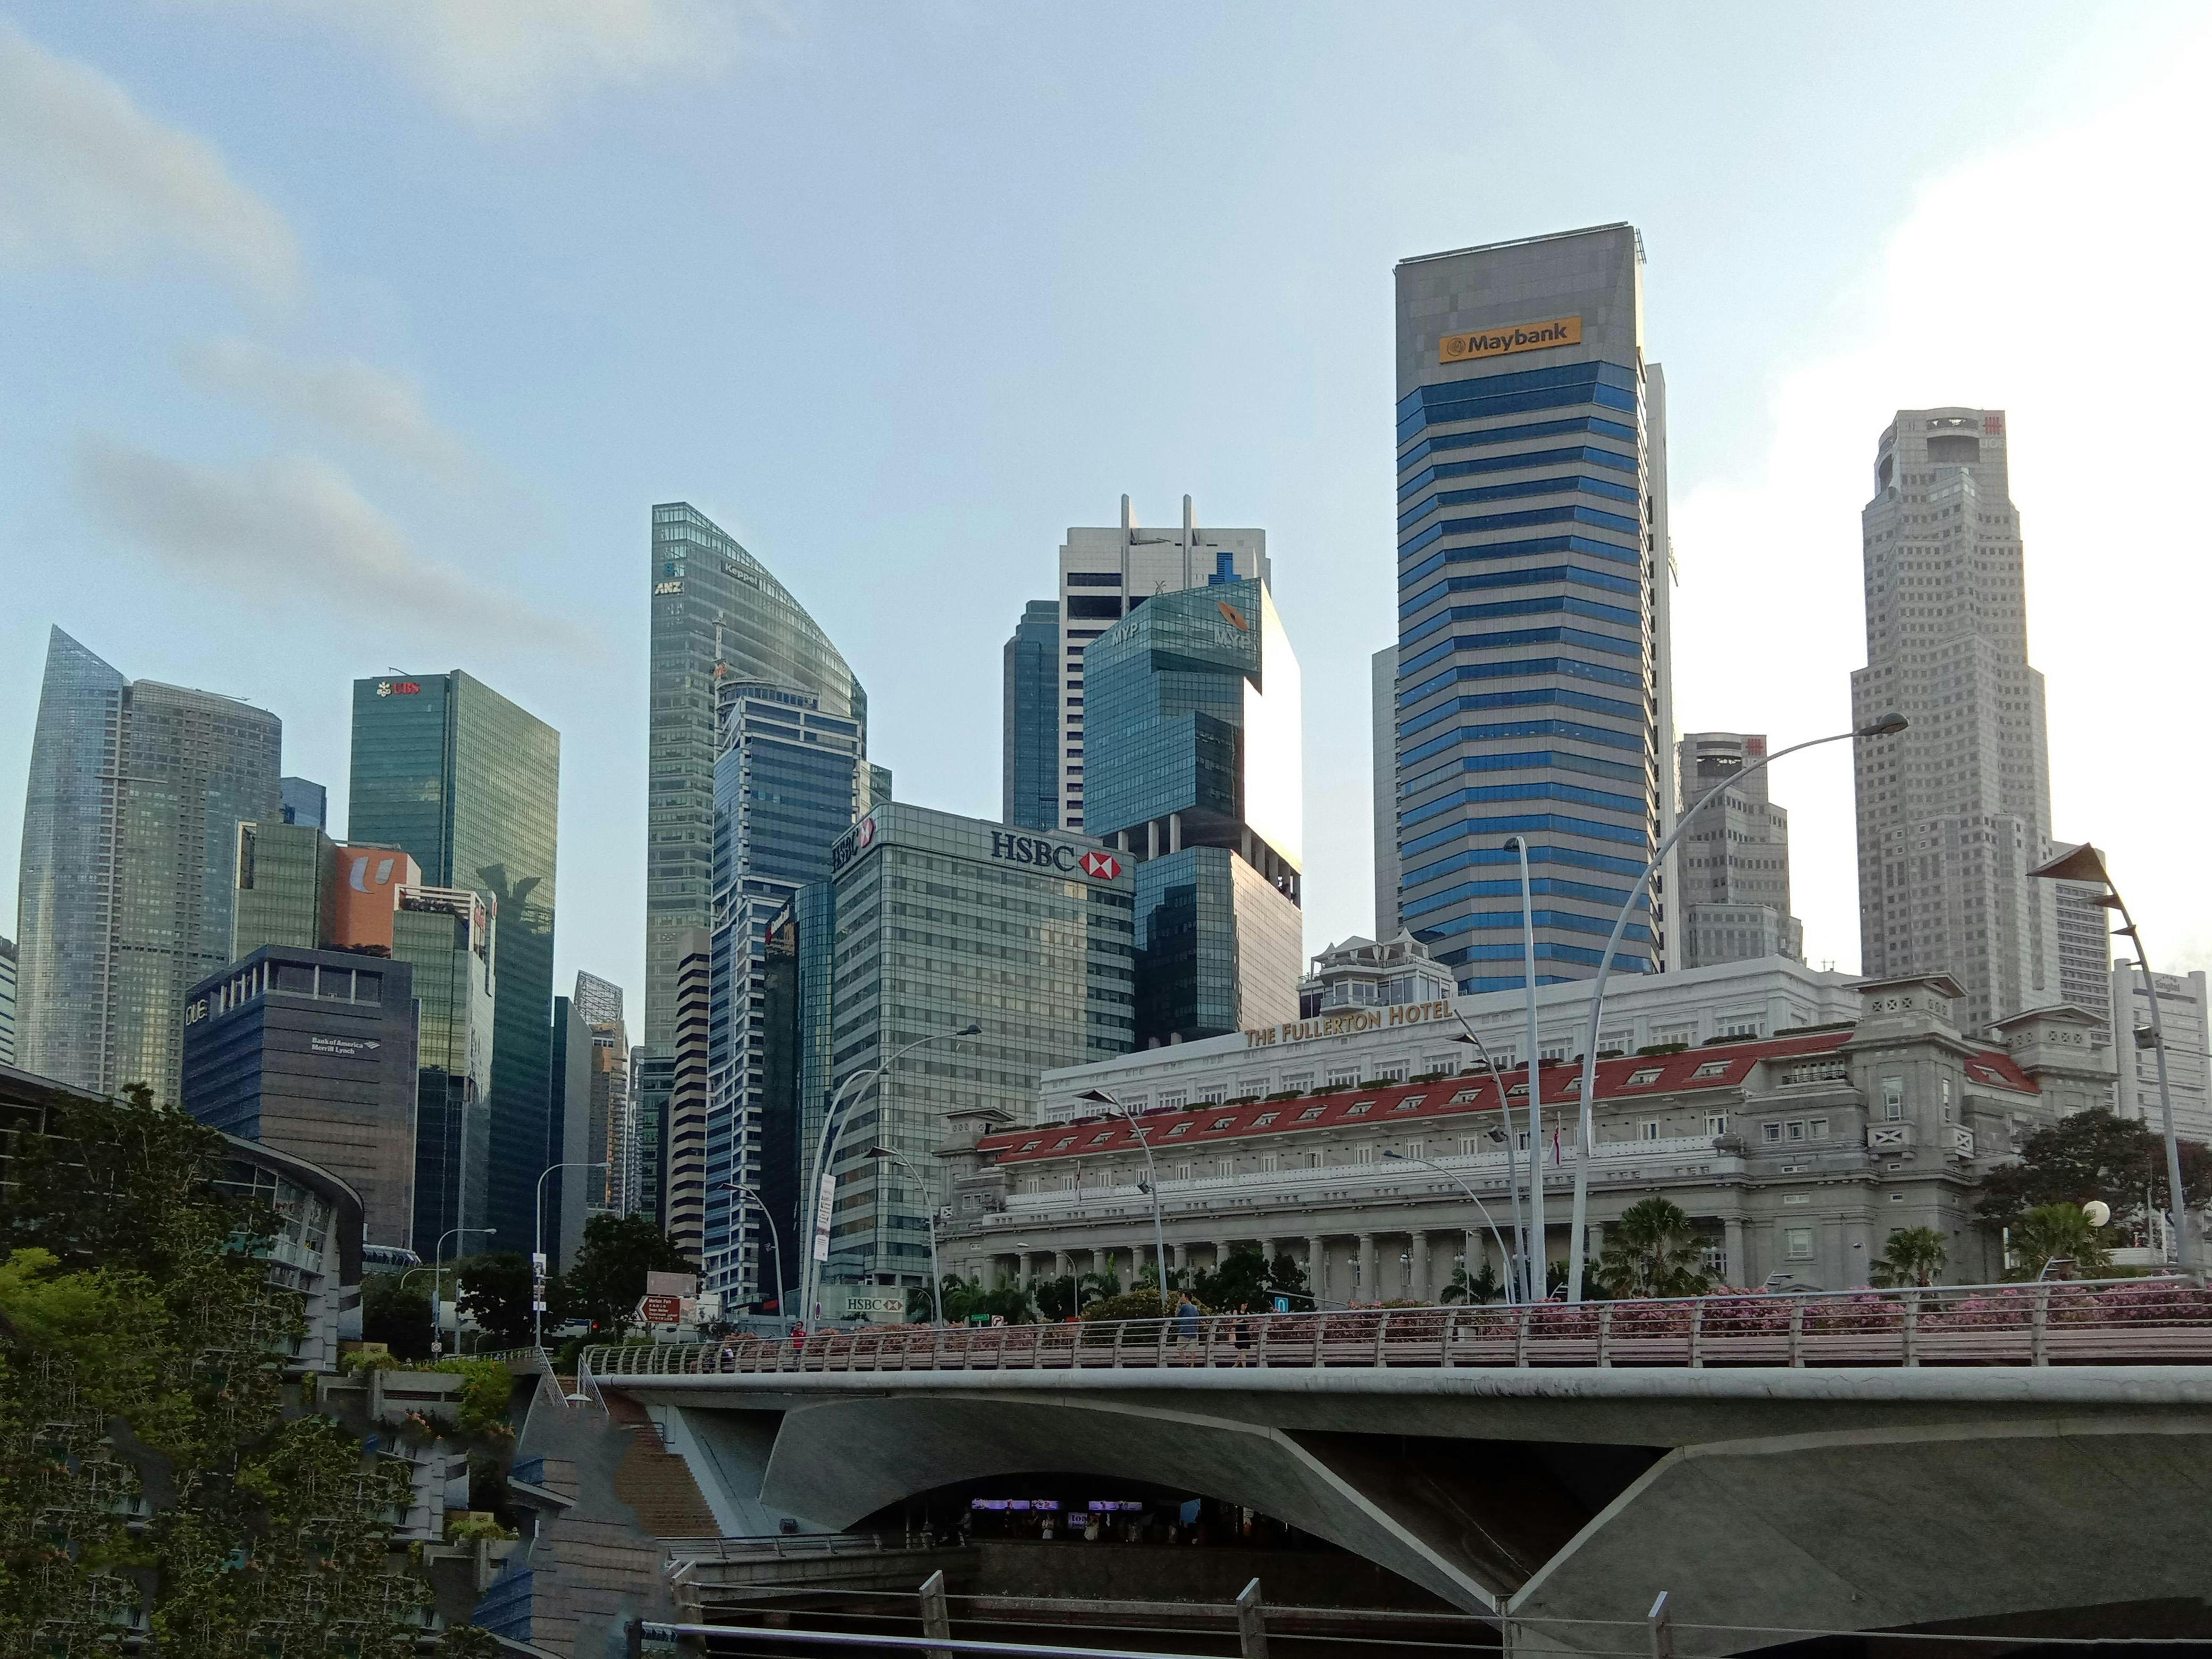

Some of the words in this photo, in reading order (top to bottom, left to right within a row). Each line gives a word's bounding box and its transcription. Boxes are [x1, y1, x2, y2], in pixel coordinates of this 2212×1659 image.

[1468, 322, 1568, 352] Maybank
[725, 562, 758, 585] Keppel
[654, 581, 683, 596] ANZ
[1111, 622, 1139, 647] MYP
[1213, 627, 1251, 649] MYP
[393, 682, 420, 694] UBS
[991, 830, 1075, 872] HSBC
[1244, 1027, 1276, 1048] THE
[1281, 1010, 1381, 1042] FULLERTON
[1389, 1000, 1453, 1026] HOTEL
[312, 1044, 334, 1052] Merrill
[335, 1046, 355, 1054] Lynch
[337, 1040, 364, 1049] America
[847, 1298, 882, 1311] HSBC
